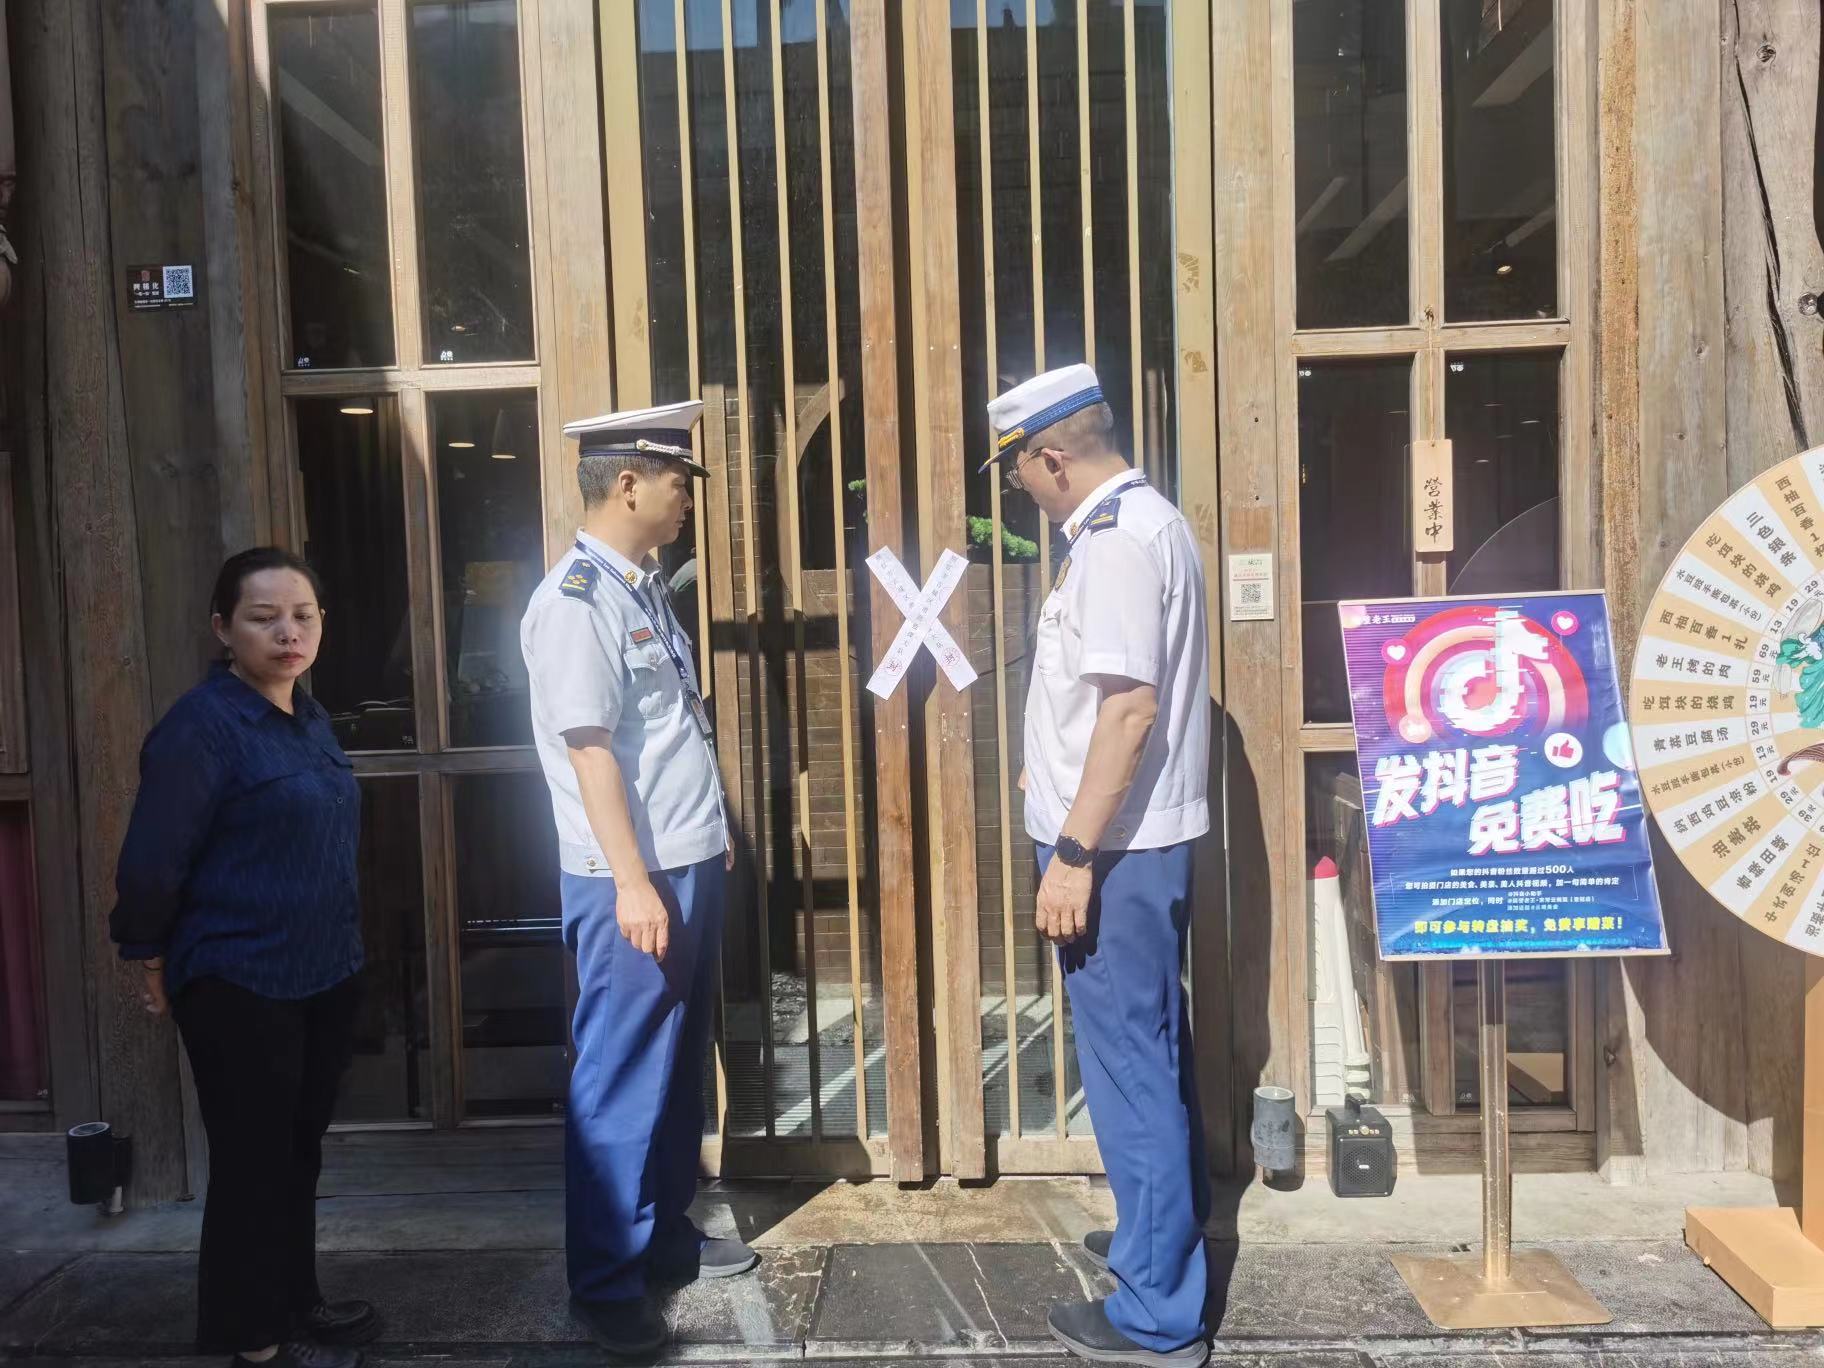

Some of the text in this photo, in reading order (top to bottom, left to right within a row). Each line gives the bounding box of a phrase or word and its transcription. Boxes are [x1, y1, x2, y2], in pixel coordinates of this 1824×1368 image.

[1746, 511, 1798, 567] 三色银条
[1705, 532, 1783, 598] 吃饵块的烧鸡
[1804, 580, 1819, 594] 29
[1785, 598, 1799, 612] 19
[1659, 609, 1748, 651] 西柚百香1扎
[1769, 620, 1783, 634] 13
[1758, 643, 1770, 658] 69
[1655, 653, 1731, 679] 老王烤的肉
[1751, 669, 1761, 684] 59
[1642, 695, 1735, 711] 吃饵块的烧鸡
[1749, 695, 1758, 709] 19
[1751, 721, 1760, 736] 29
[1654, 727, 1729, 752] 青菜豆腐汤
[1755, 745, 1768, 760] 13
[1765, 769, 1778, 784] 19
[1372, 744, 1520, 827] 发抖音
[1780, 791, 1793, 805] 29
[1466, 770, 1627, 857] 免费吃
[1673, 781, 1759, 834] 纳西鸡豆凉粉
[1798, 810, 1813, 823] 39
[1711, 815, 1762, 859] 油麦菜
[1736, 834, 1790, 890] 香辣田螺
[1764, 843, 1822, 922] 中式例汤1位
